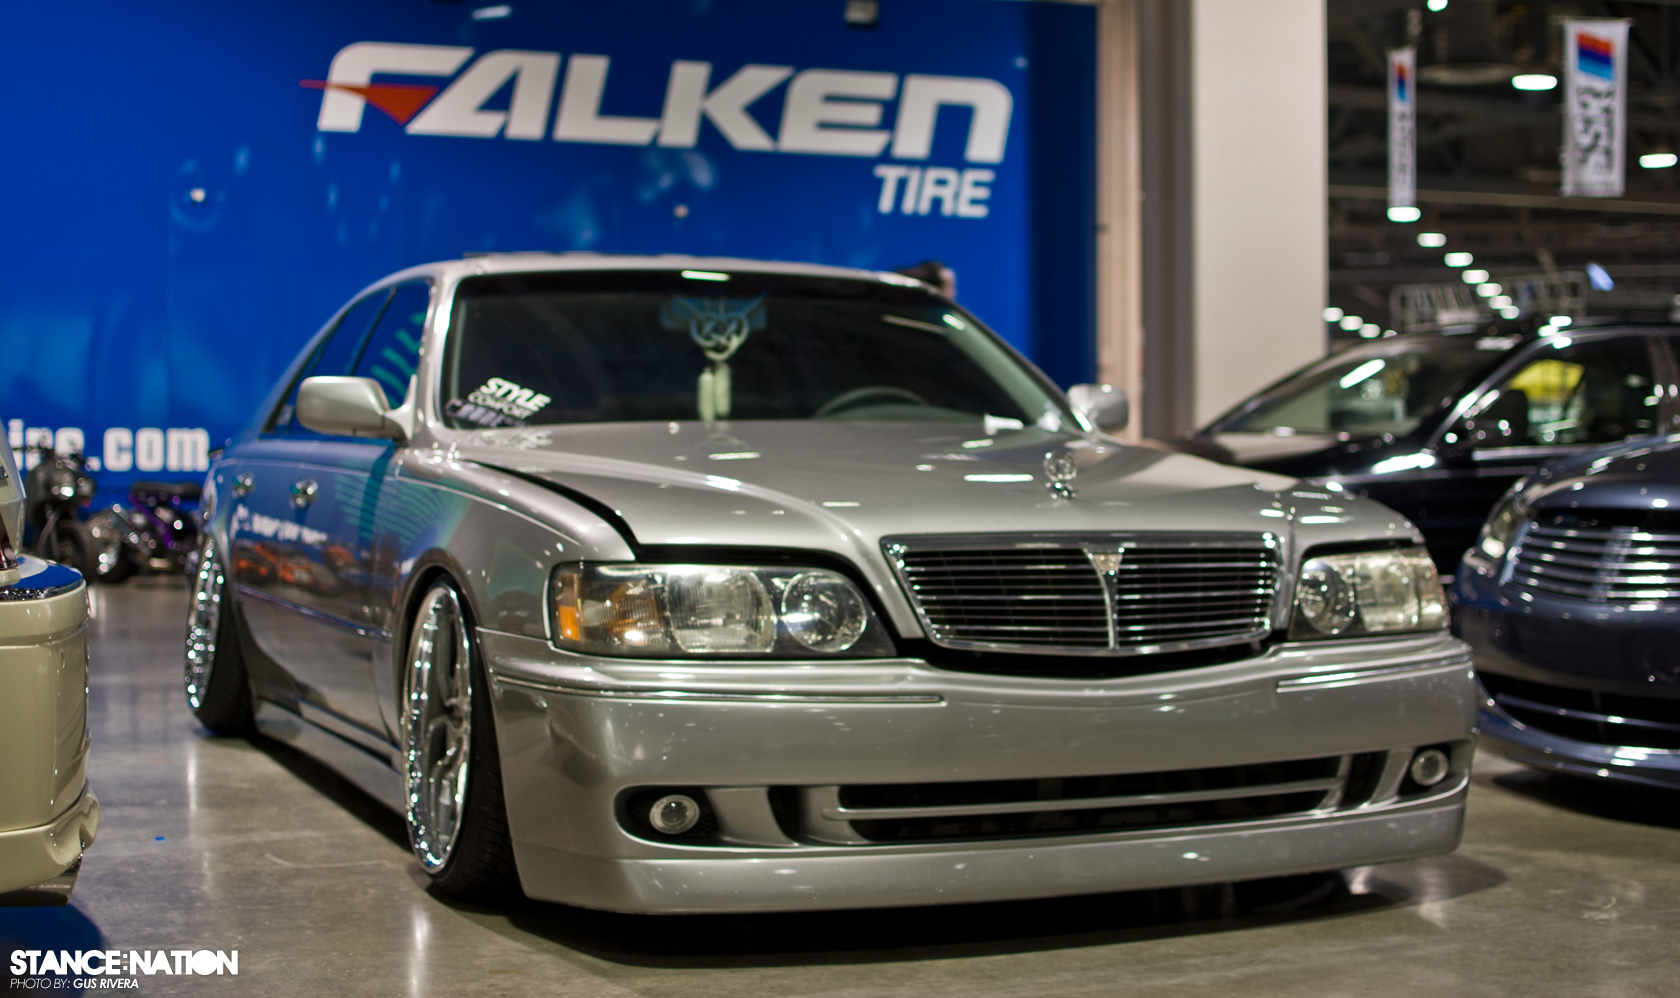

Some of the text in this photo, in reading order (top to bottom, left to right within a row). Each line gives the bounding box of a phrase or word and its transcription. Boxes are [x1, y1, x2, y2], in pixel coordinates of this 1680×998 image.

[317, 41, 1014, 164] FALKEN
[874, 164, 996, 219] TIRE
[479, 377, 552, 412] STYLE
